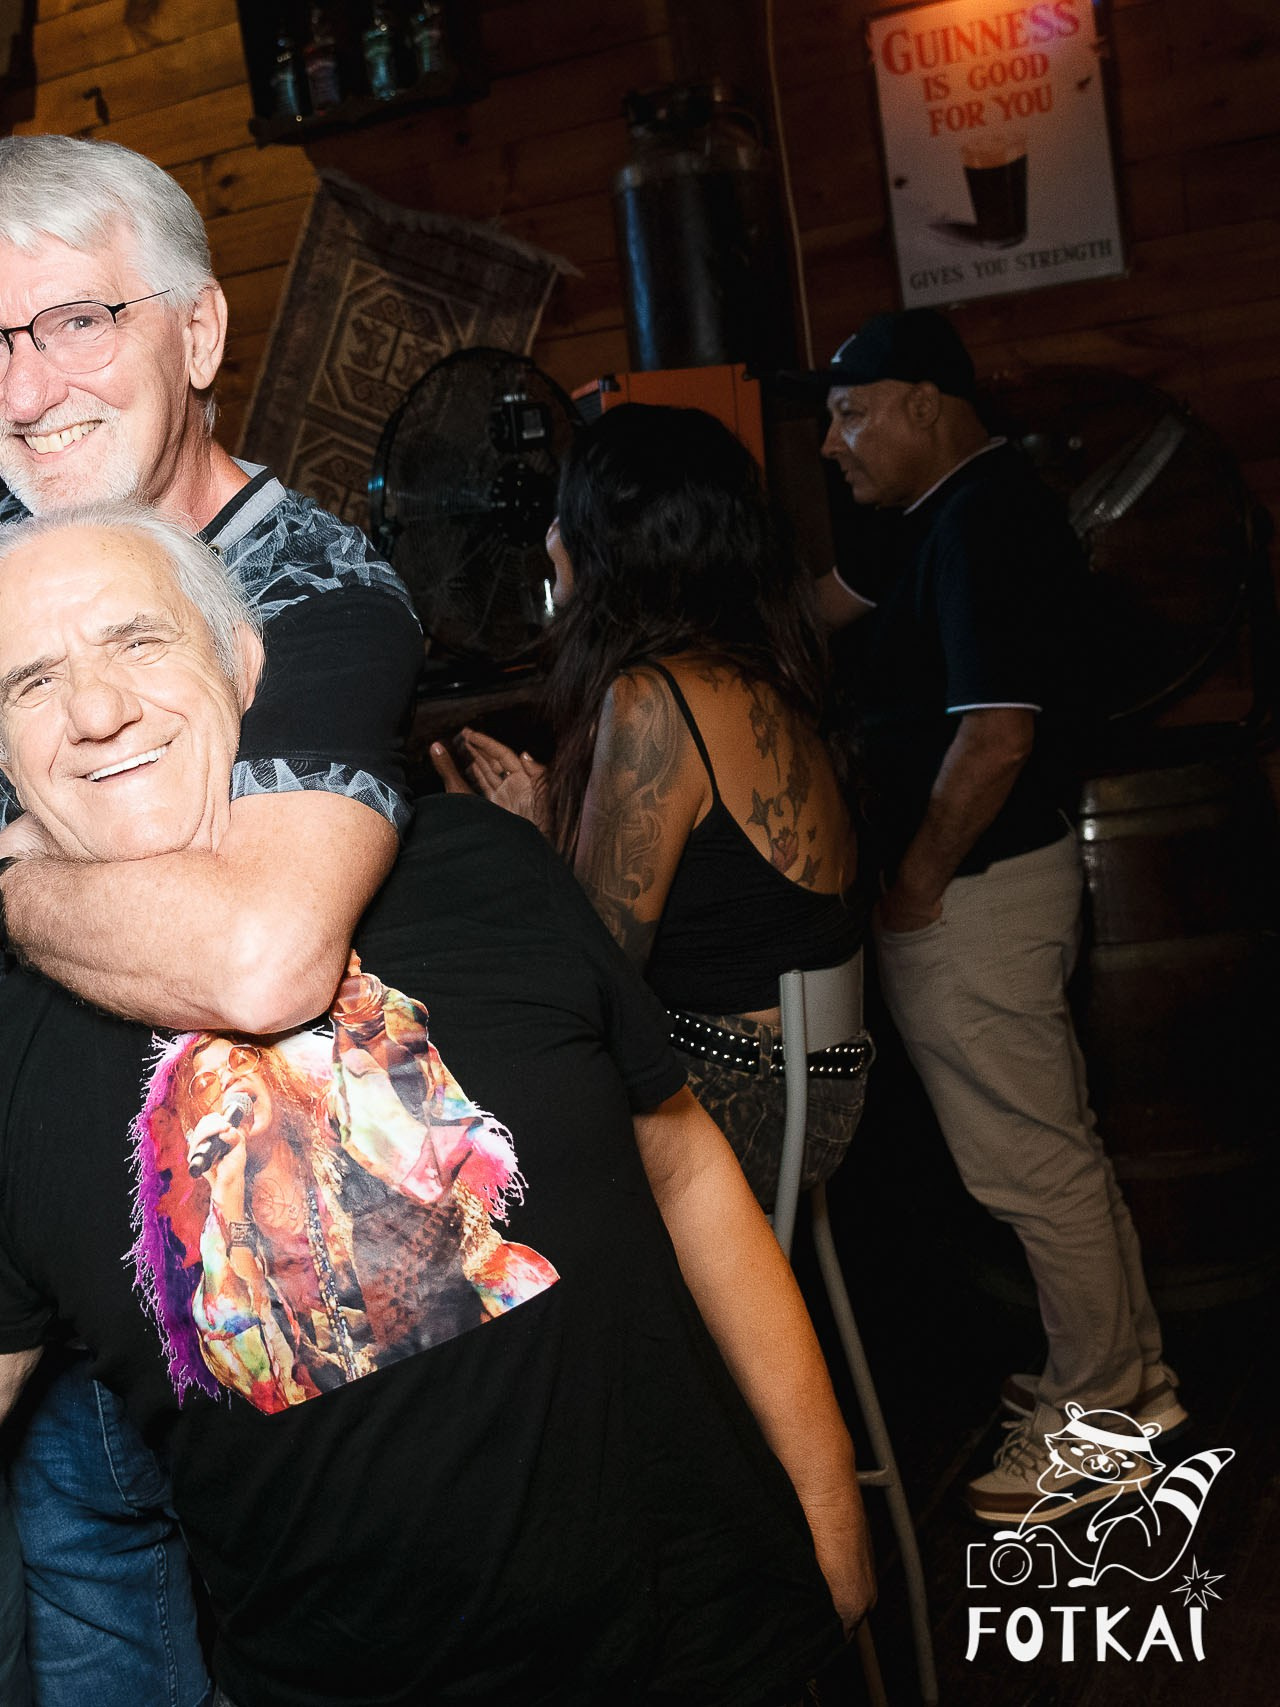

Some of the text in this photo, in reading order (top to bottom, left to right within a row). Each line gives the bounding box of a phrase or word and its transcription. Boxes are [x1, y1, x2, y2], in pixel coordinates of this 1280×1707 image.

[881, 0, 1080, 76] GUINNESS
[922, 53, 1050, 102] IS GOOD
[928, 84, 1054, 138] FOR YOU
[908, 238, 1113, 291] GIVES YOU STRENGTH
